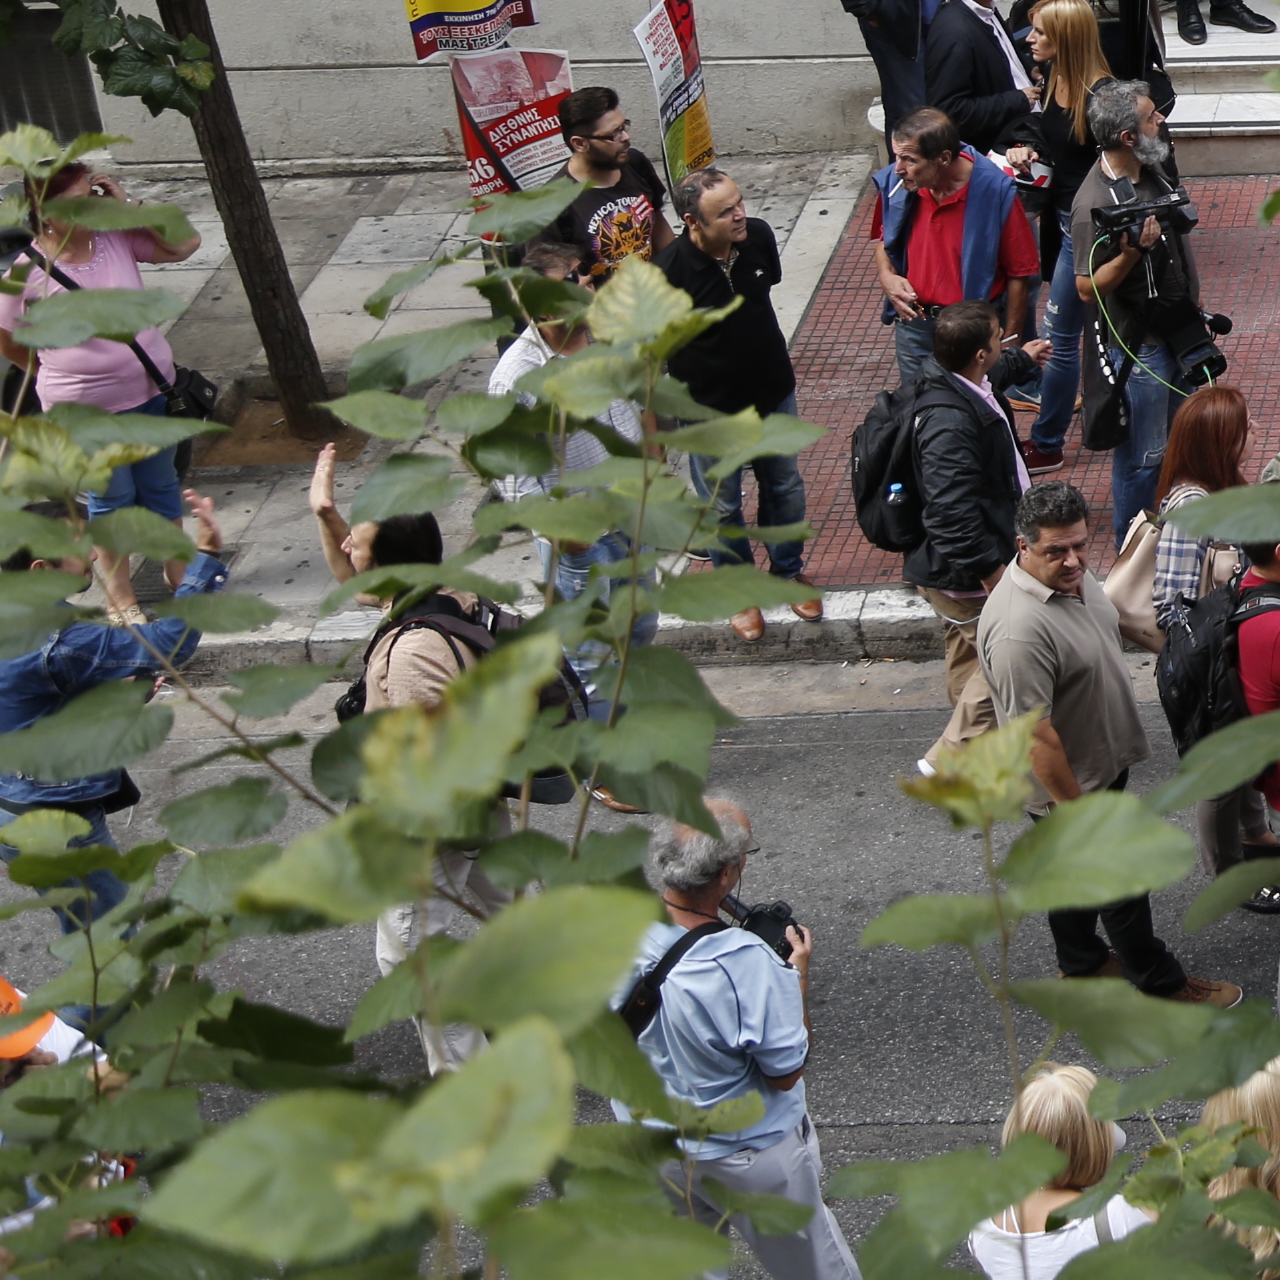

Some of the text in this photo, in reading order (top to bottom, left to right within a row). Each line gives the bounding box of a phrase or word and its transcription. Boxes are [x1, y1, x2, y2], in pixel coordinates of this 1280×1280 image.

[443, 12, 485, 23] ΕΚΚΙΝΗΣΗ
[419, 25, 450, 44] ΤΟΥΣ
[436, 37, 469, 50] ΜΑΣ
[488, 107, 542, 143] ΔΙΕΘΝΗΣ
[587, 201, 616, 234] MEXICO
